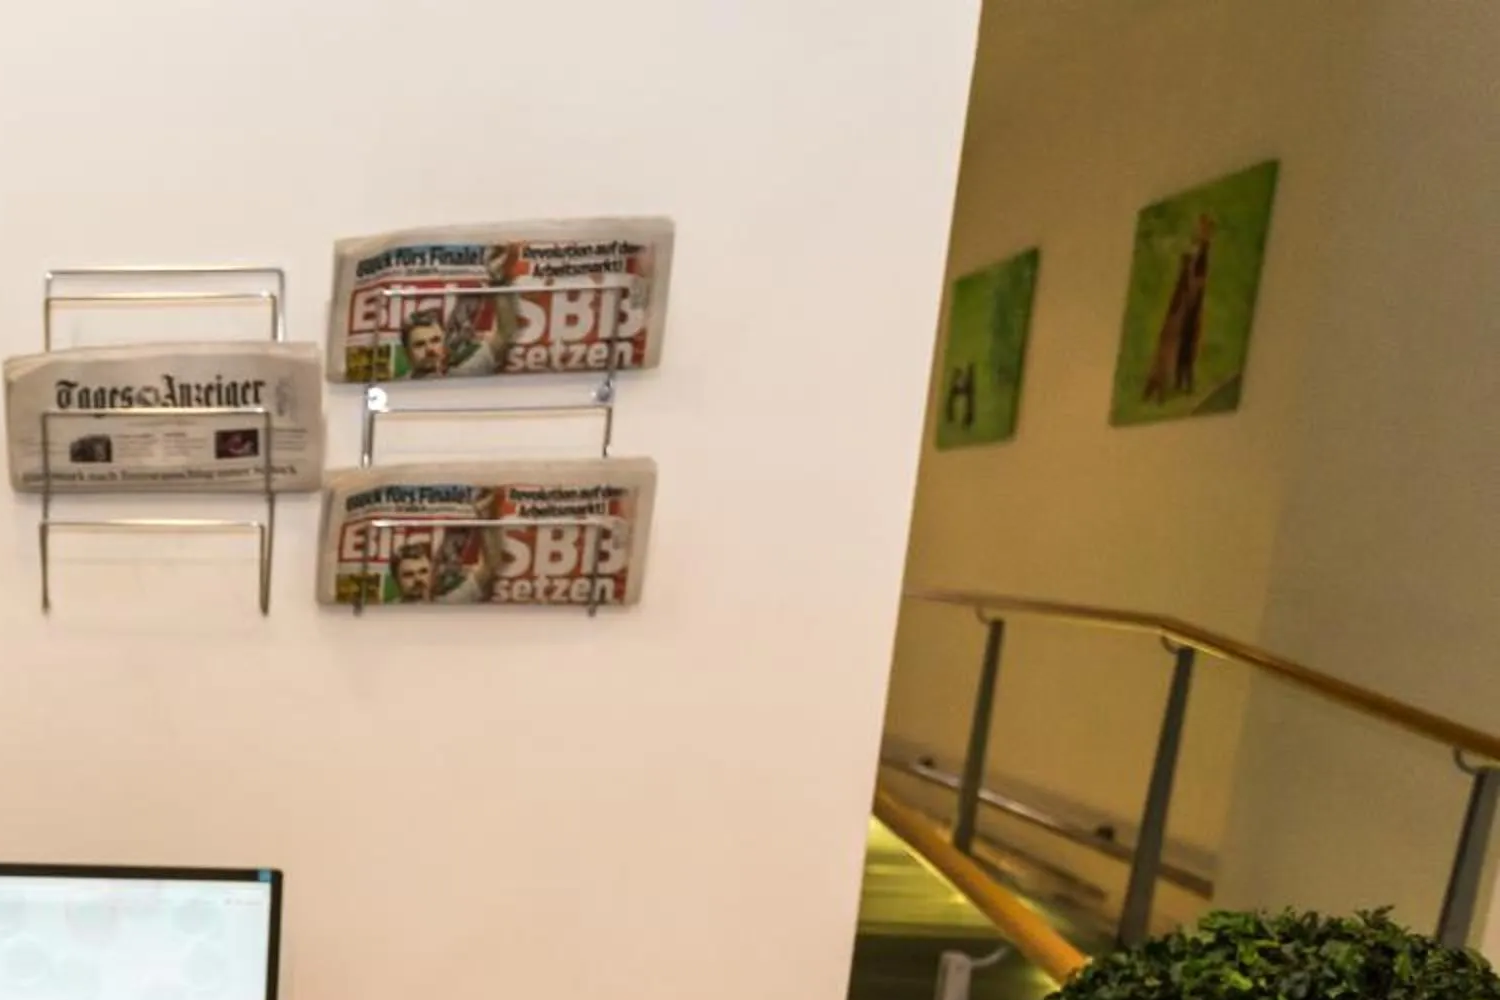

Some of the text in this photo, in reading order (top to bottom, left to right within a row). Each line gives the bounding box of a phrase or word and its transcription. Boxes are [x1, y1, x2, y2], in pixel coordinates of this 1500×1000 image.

[506, 341, 634, 372] setzen
[55, 374, 266, 415] Tages Anzeiger
[493, 576, 616, 603] setzen
